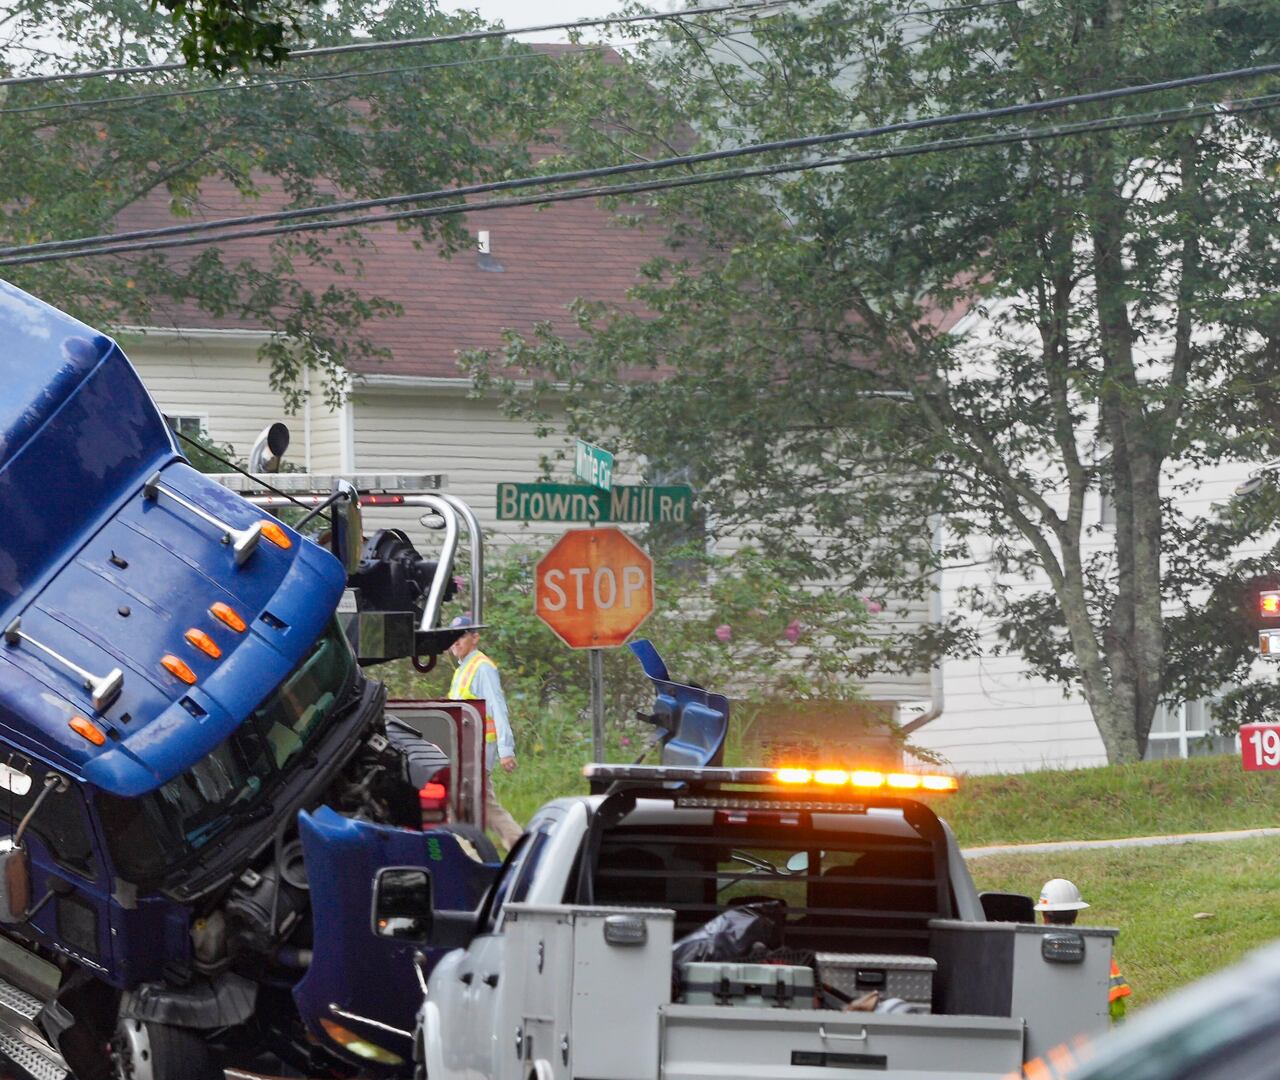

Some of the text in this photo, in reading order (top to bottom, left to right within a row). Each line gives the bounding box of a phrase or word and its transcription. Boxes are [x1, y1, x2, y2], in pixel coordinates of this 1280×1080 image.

[500, 484, 686, 522] Browns Mill Rd
[543, 566, 645, 612] STOP
